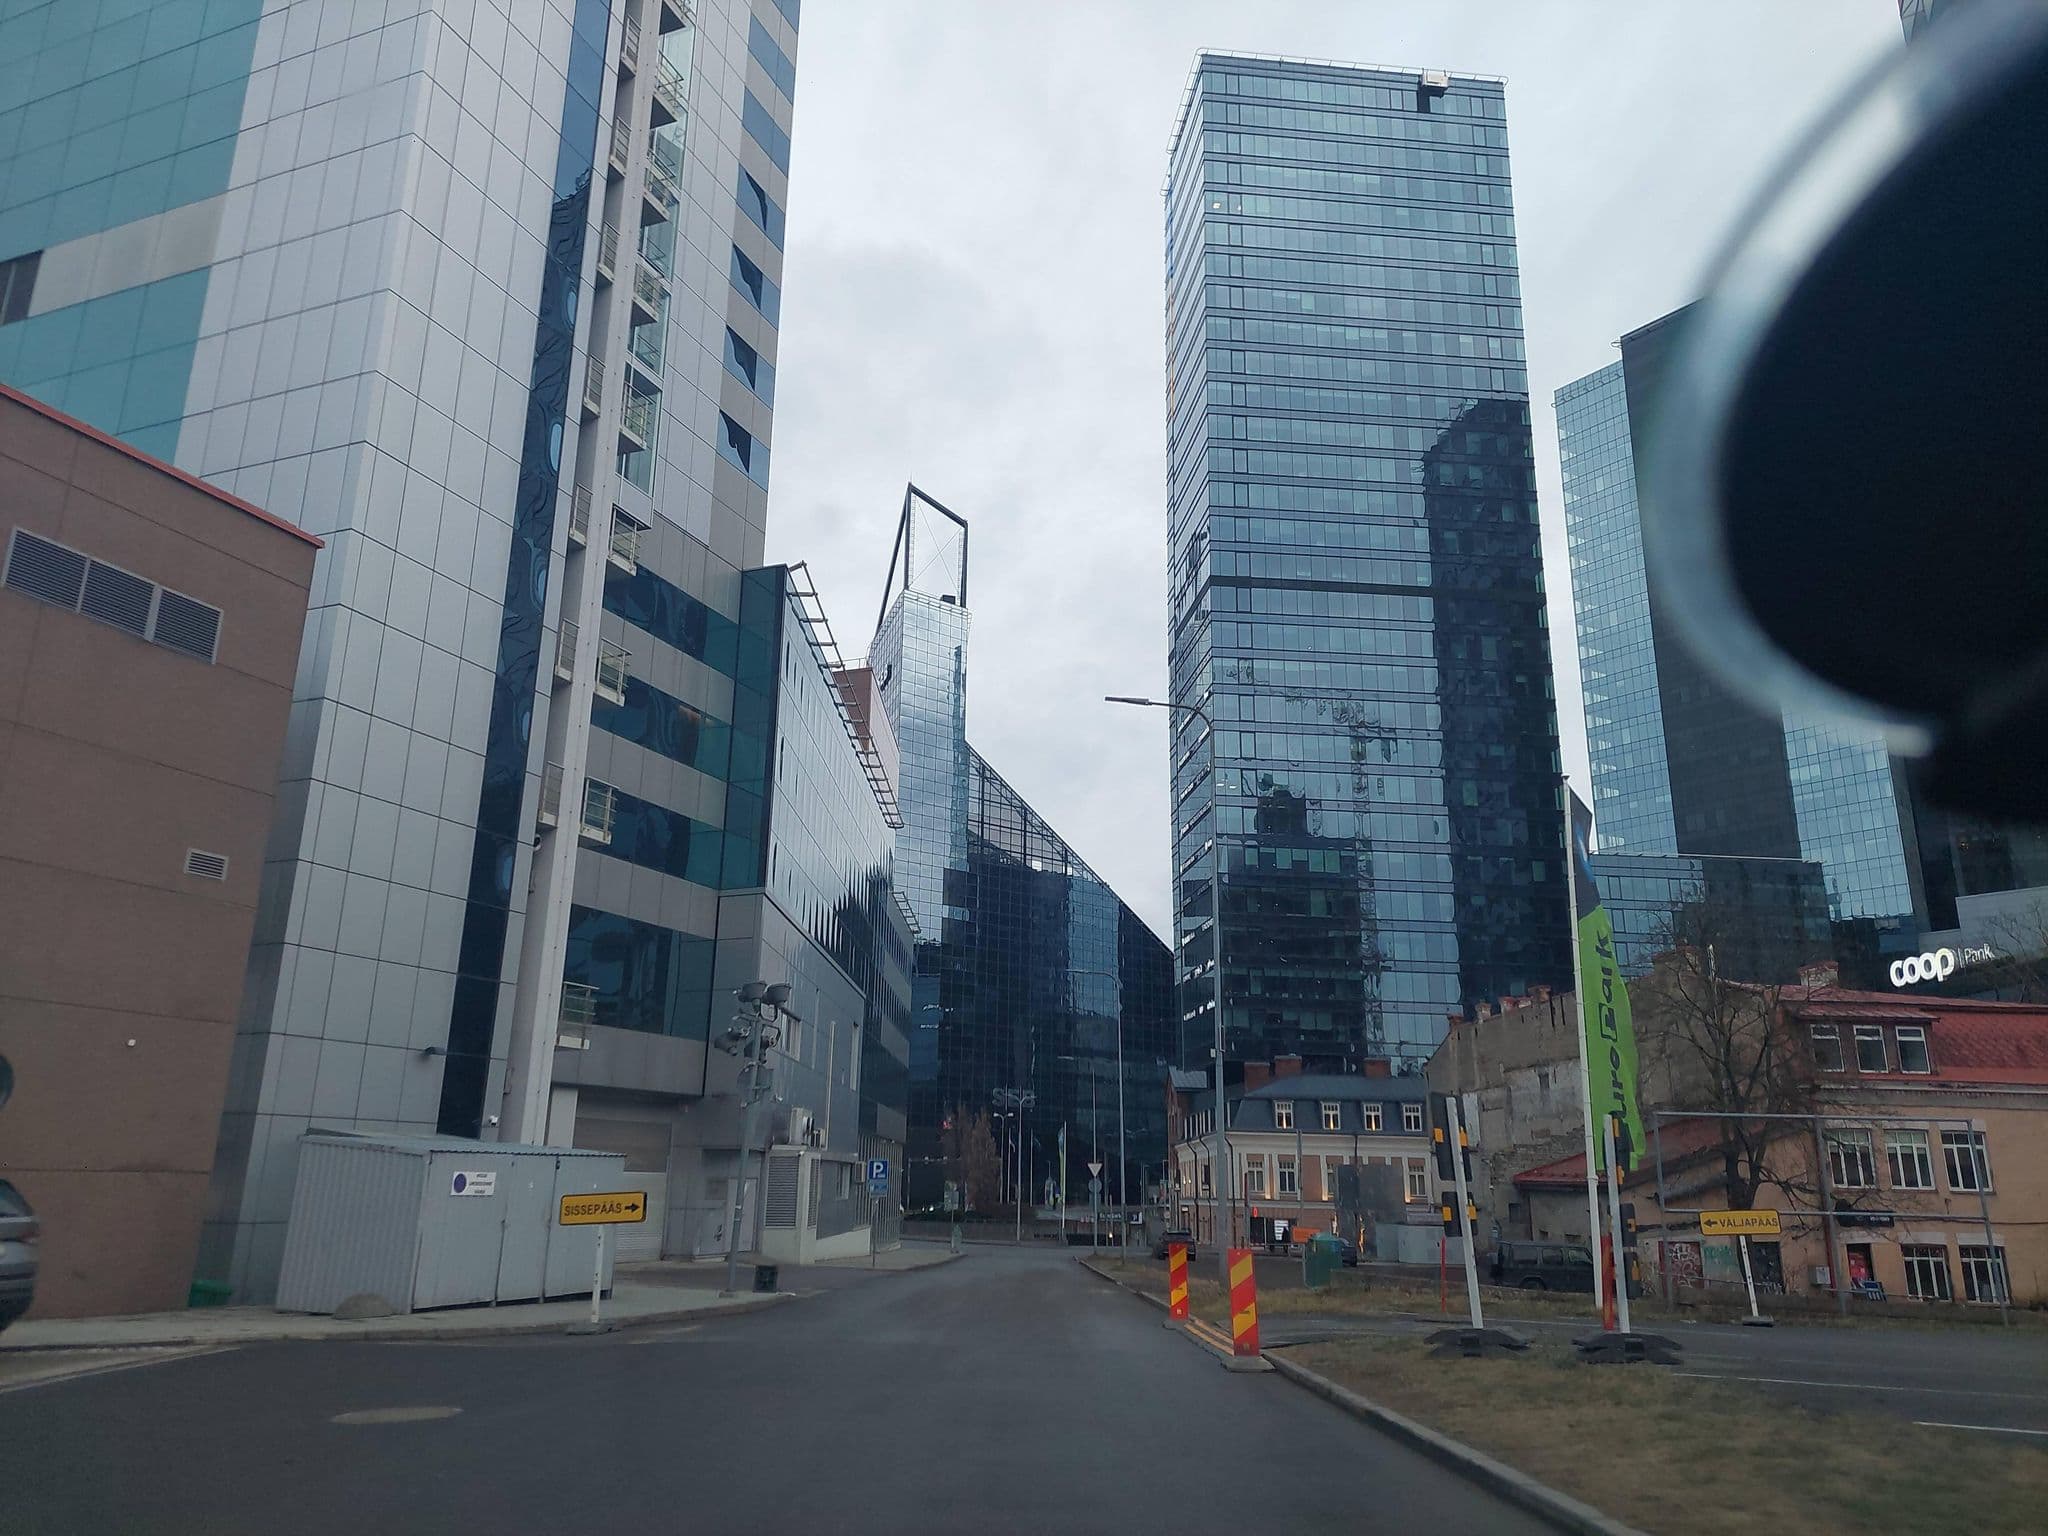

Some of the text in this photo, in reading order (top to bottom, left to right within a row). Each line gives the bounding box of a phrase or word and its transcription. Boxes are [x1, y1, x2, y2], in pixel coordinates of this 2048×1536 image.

[1890, 943, 1995, 987] coop Pank
[992, 1088, 1036, 1108] SEB
